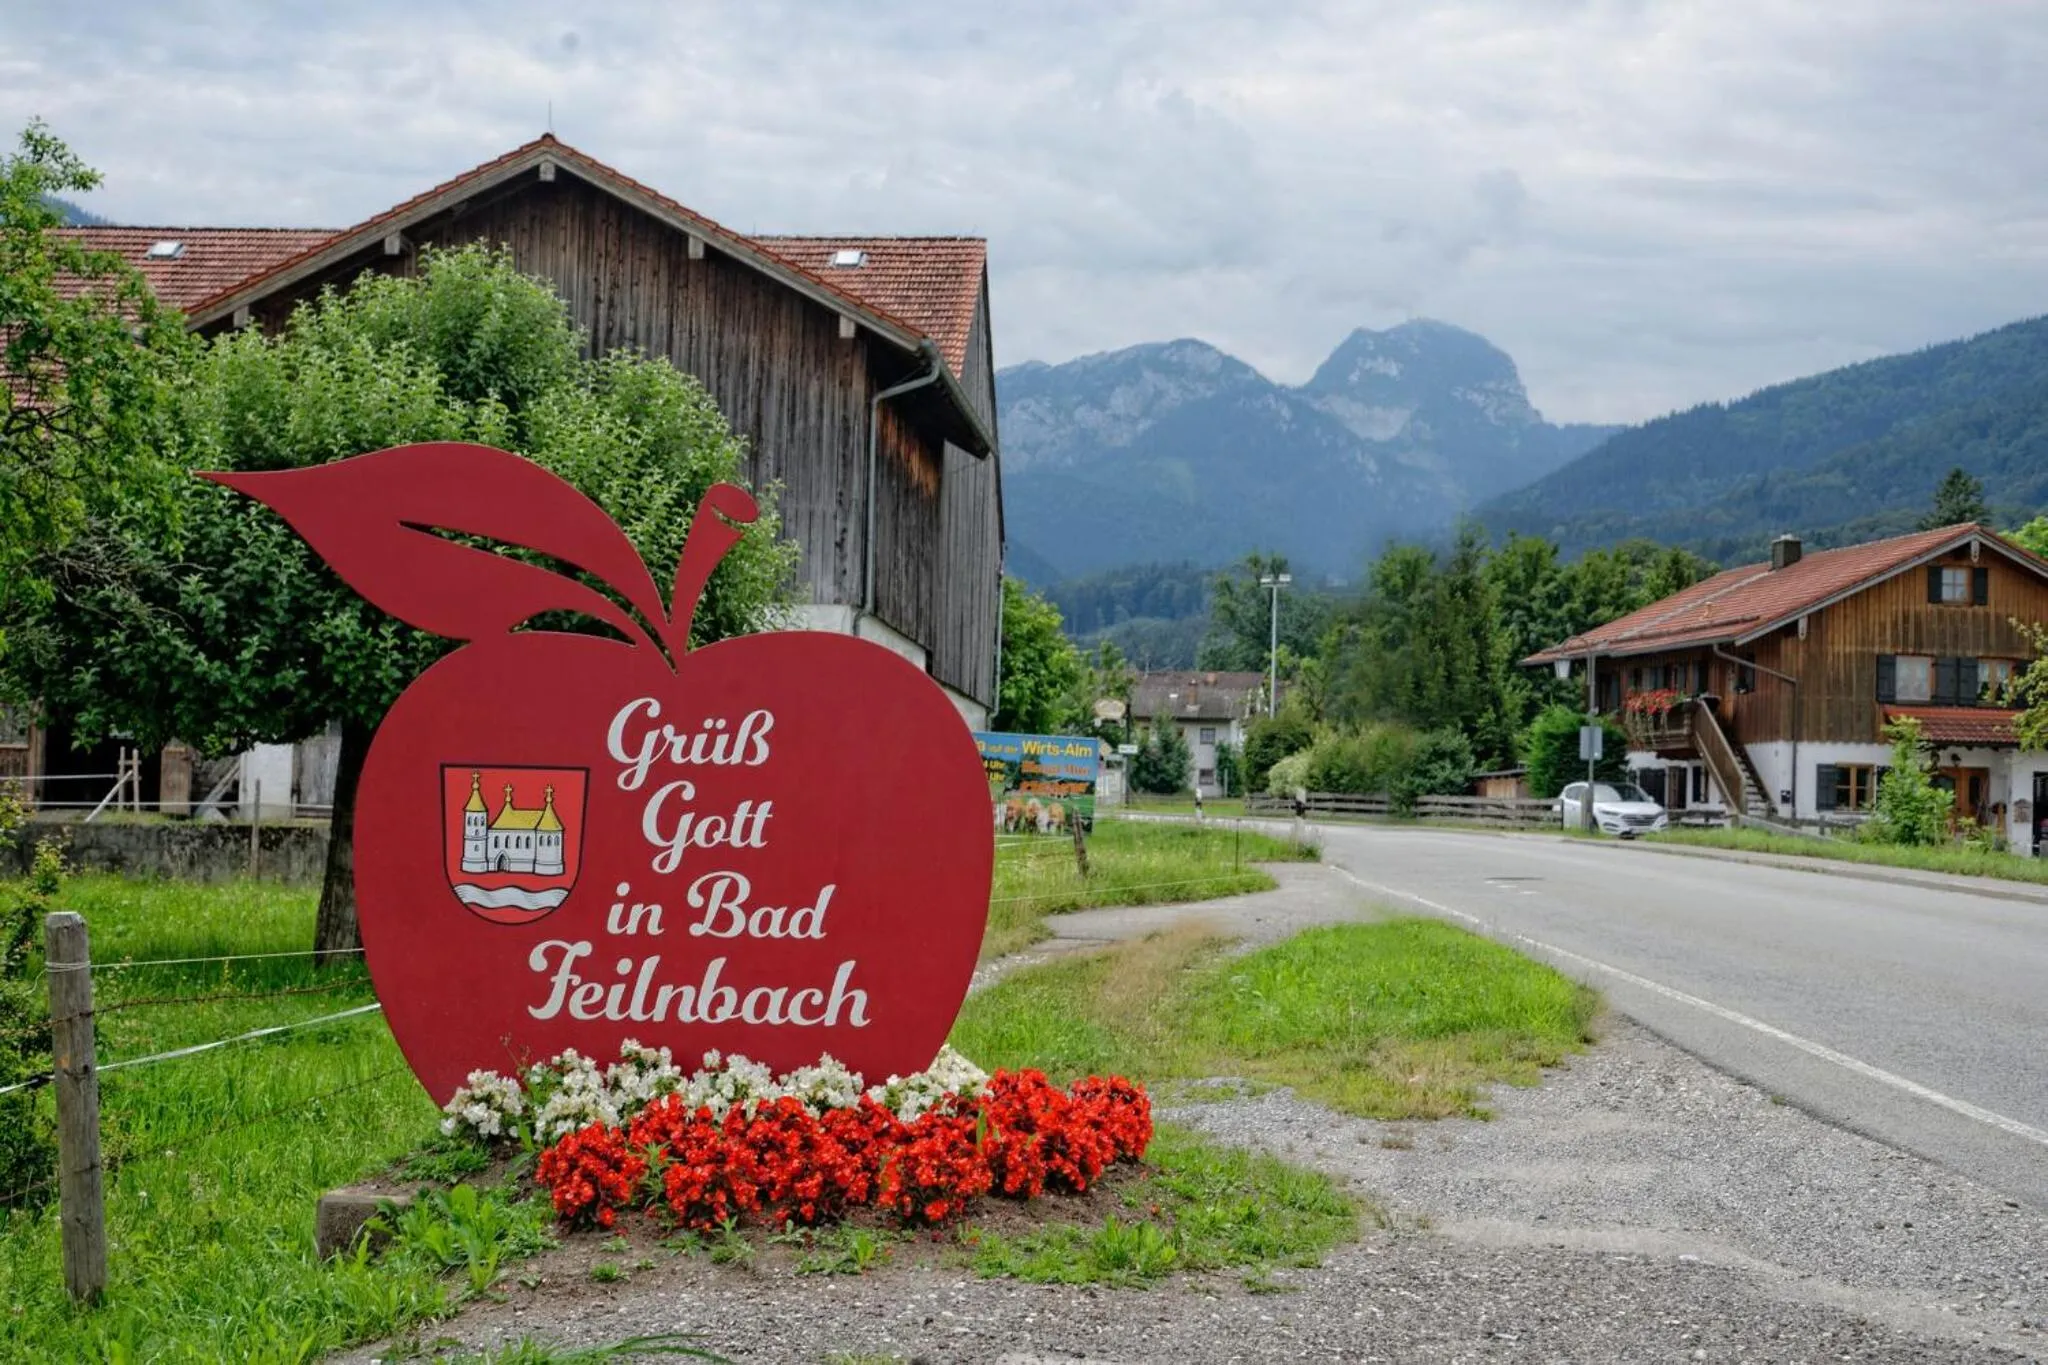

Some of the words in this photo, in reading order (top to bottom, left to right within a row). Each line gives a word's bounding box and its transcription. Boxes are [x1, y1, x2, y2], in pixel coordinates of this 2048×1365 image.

[607, 697, 775, 791] Grüß
[1022, 740, 1093, 757] Wirts-Alm
[642, 780, 774, 874] Gott
[607, 882, 665, 936] in
[687, 870, 836, 940] Bad
[527, 939, 872, 1027] Feilnbach
